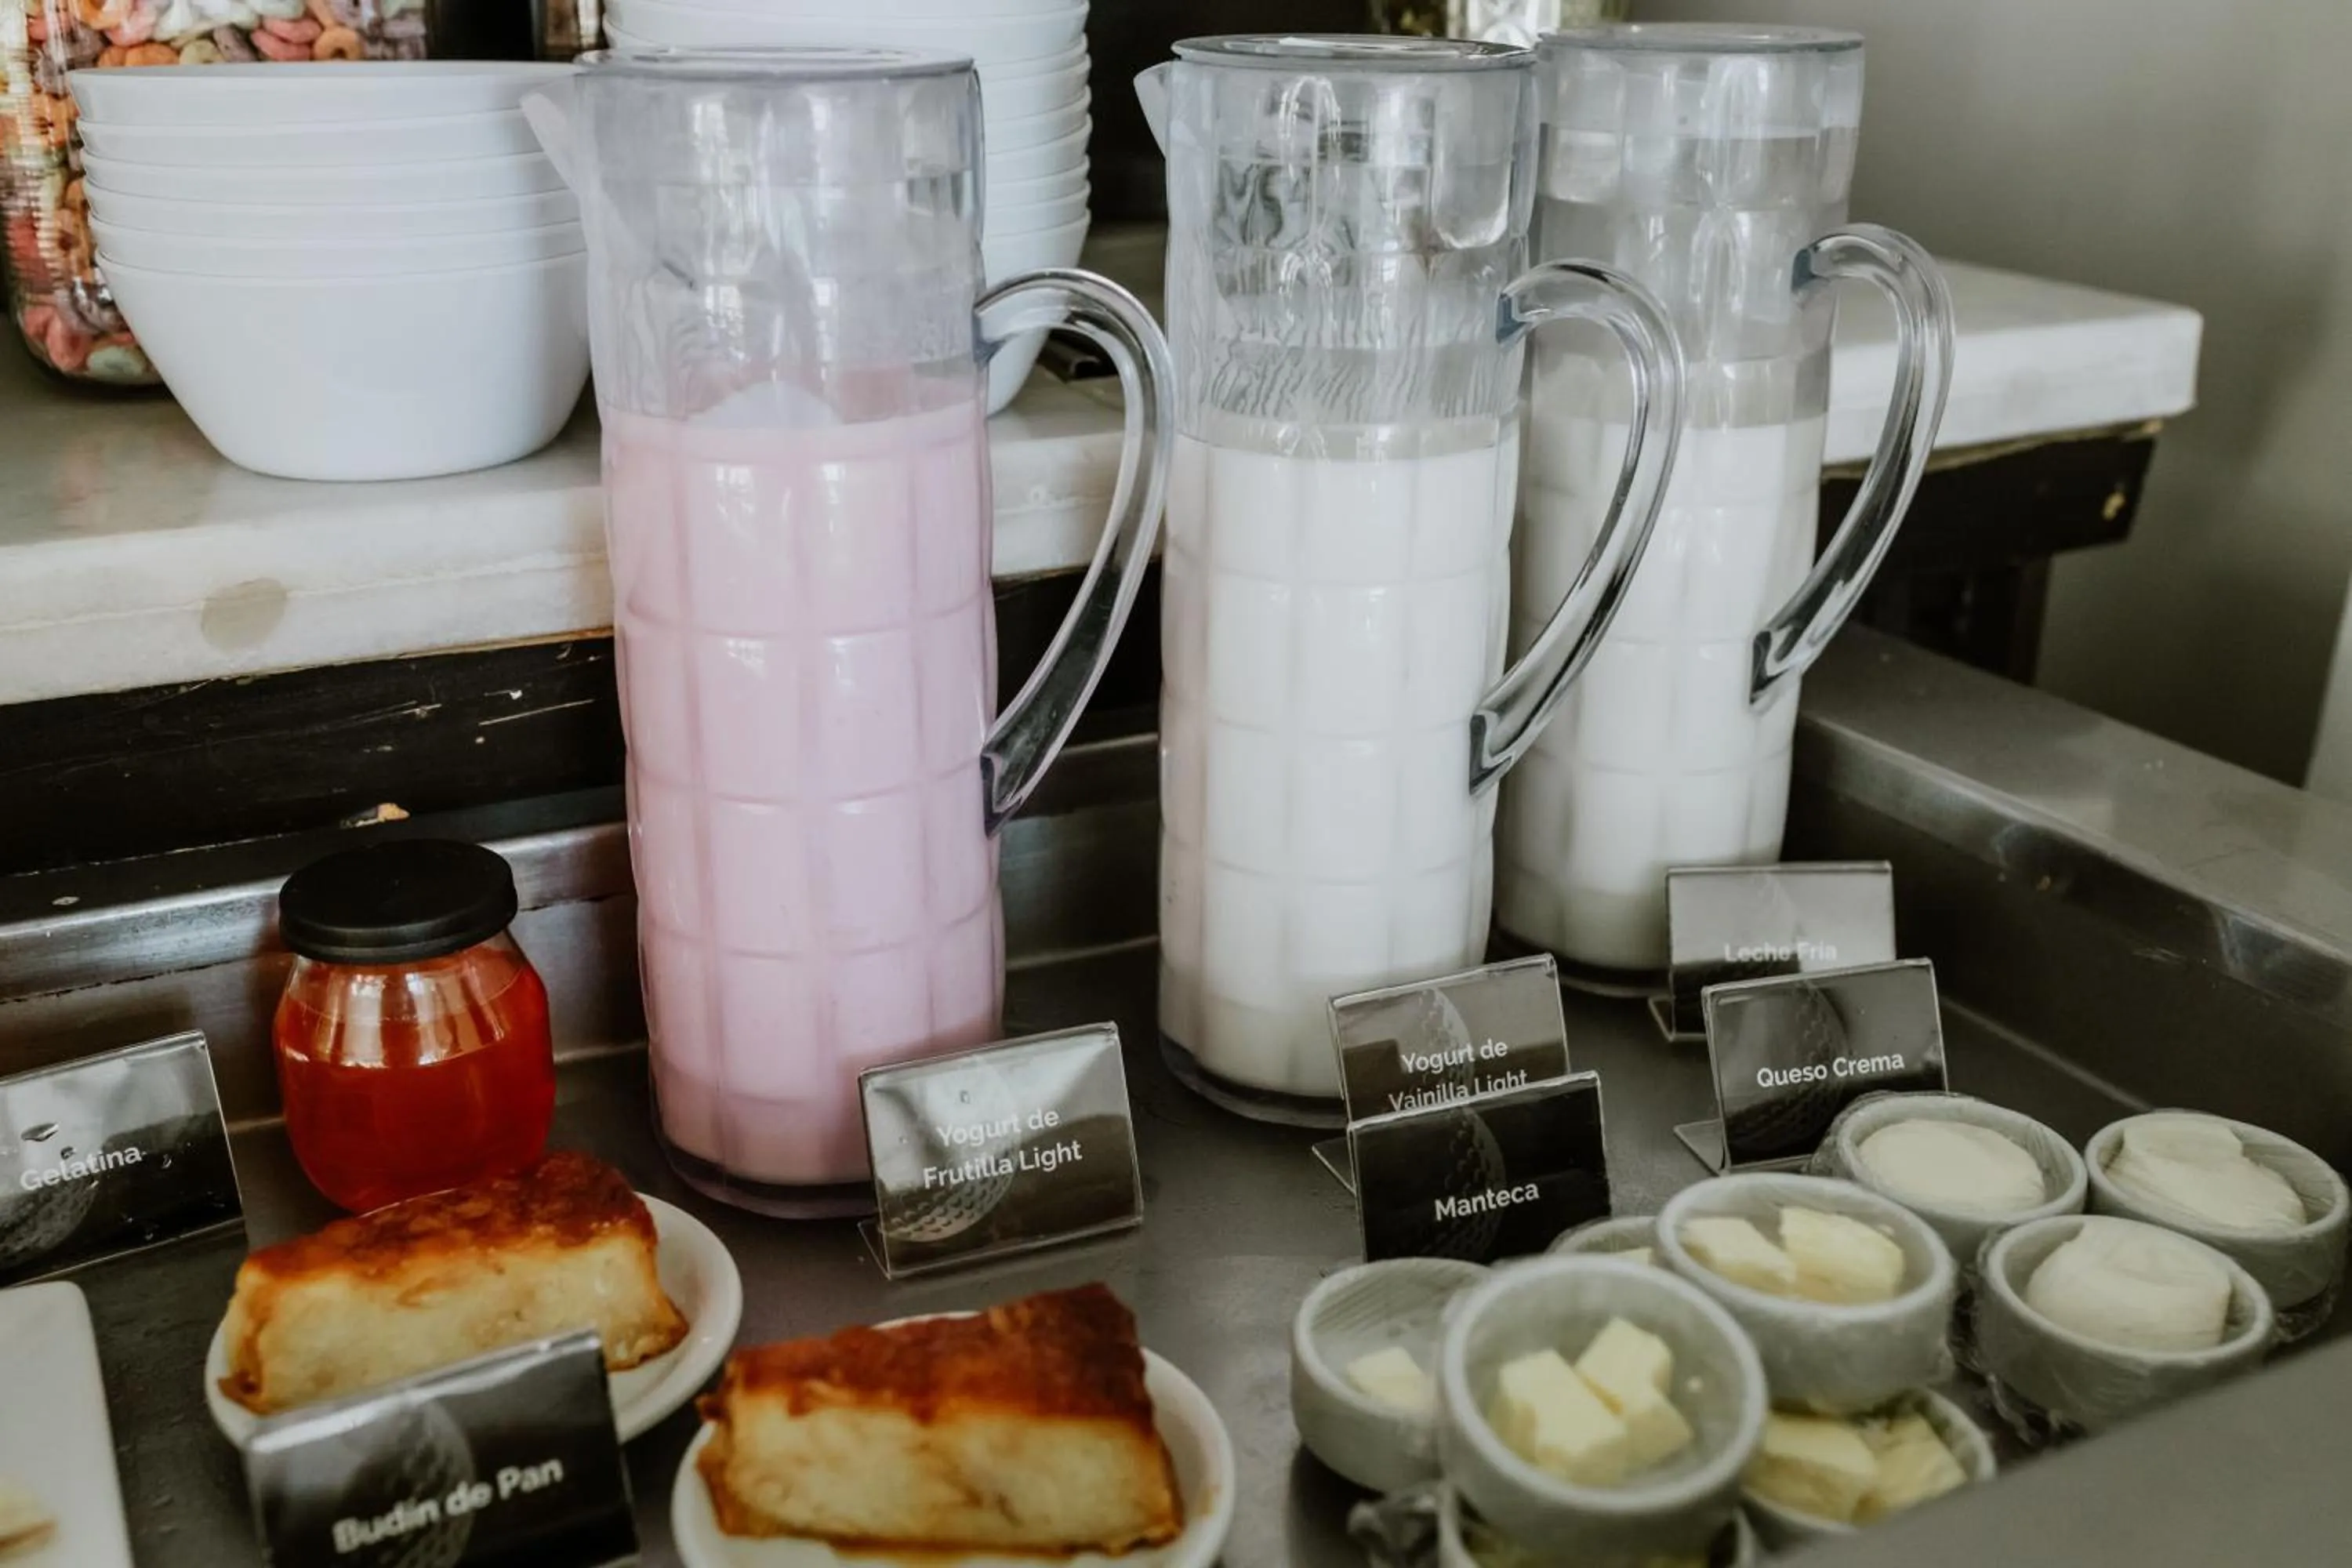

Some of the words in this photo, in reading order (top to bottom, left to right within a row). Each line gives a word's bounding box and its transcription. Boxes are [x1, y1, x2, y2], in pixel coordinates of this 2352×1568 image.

[1724, 942, 1790, 962] Leche
[1401, 1044, 1475, 1074] Yogurt
[1479, 1039, 1508, 1059] de
[1757, 1064, 1828, 1087] Queso
[1832, 1053, 1905, 1078] Crema
[1388, 1081, 1469, 1112] Vainilla
[1474, 1069, 1528, 1092] Light
[937, 1114, 1022, 1147] Yogurt
[1028, 1108, 1059, 1130] de
[20, 1146, 142, 1191] Gelatina
[923, 1153, 1014, 1189] Frutilla
[1019, 1140, 1083, 1173] Light
[1434, 1181, 1540, 1221] Manteca
[445, 1480, 492, 1516] de
[496, 1458, 564, 1500] Pan
